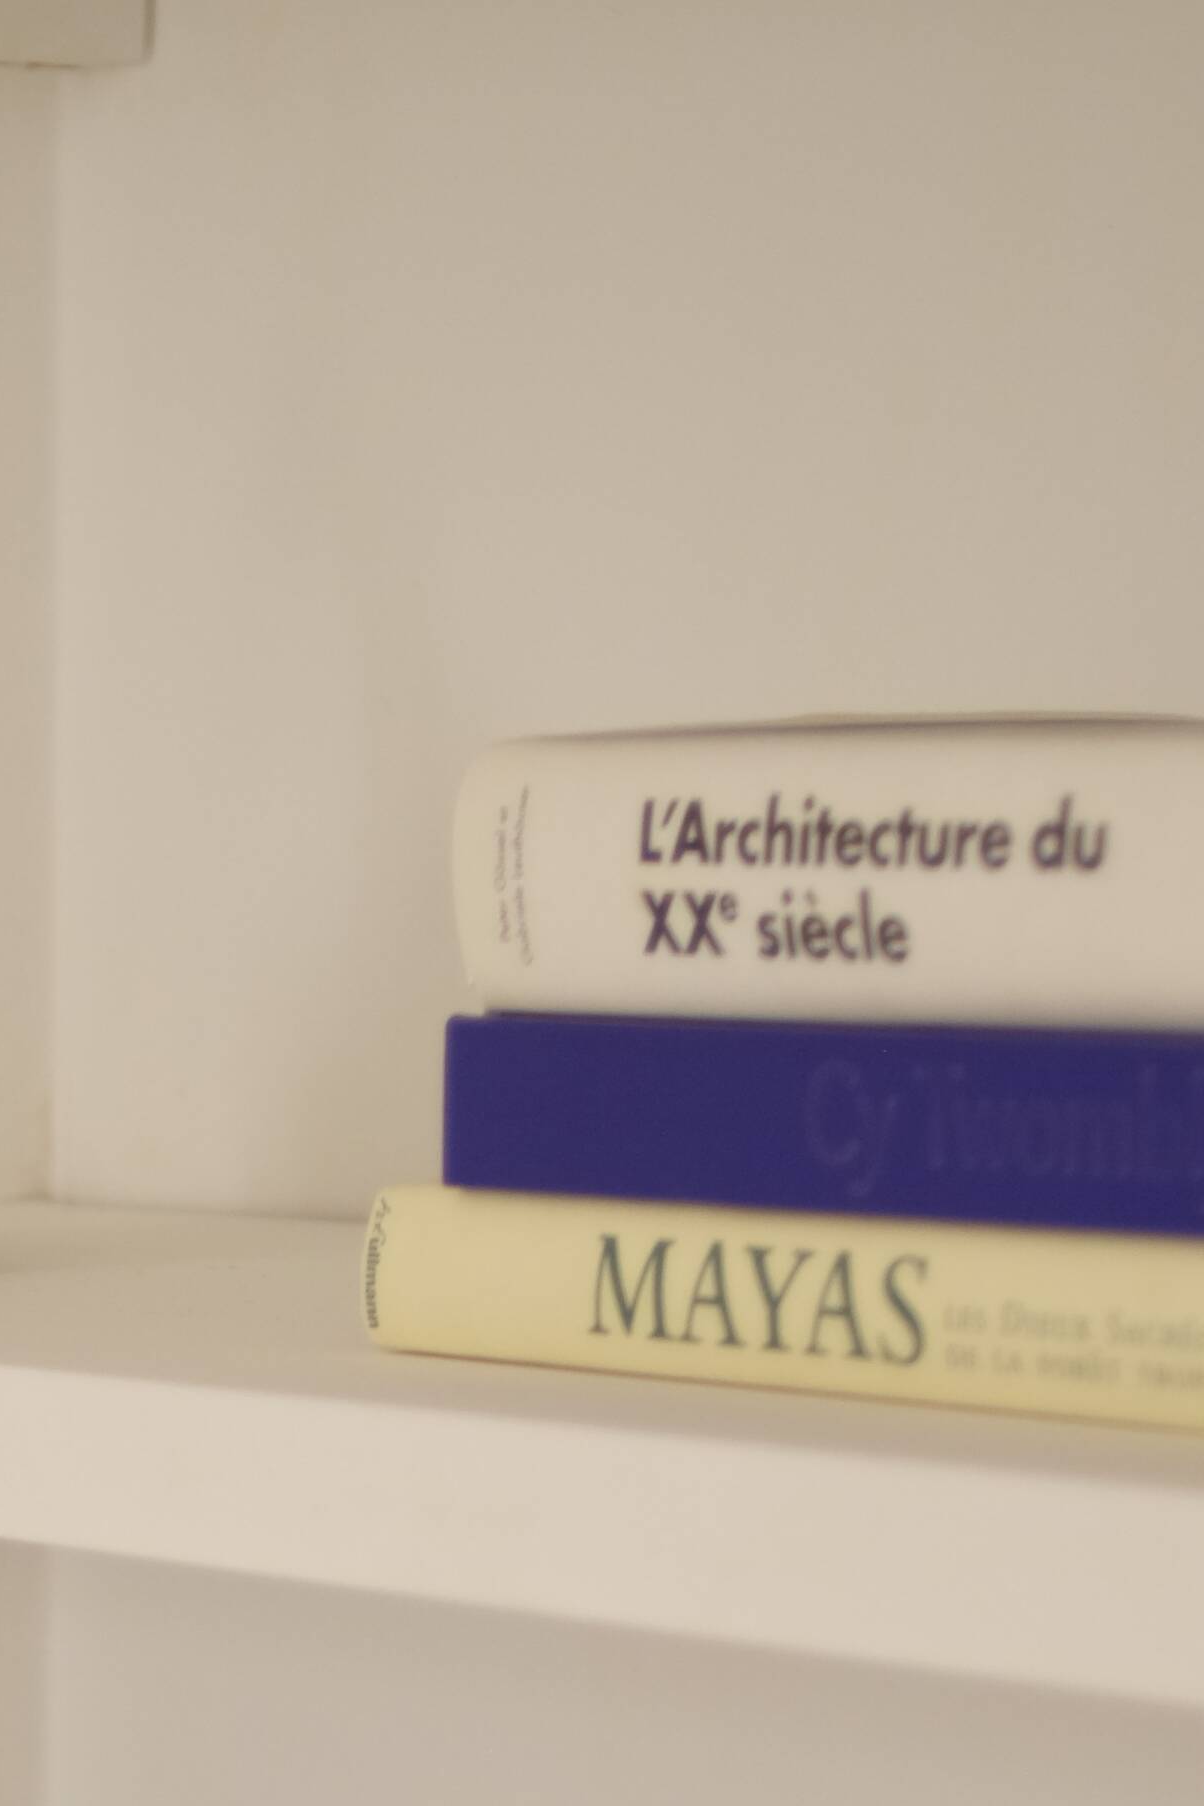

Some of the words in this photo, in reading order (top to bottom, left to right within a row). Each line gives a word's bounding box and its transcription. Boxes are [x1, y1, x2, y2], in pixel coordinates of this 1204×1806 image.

[638, 793, 1013, 869] L'Architecture
[1031, 794, 1109, 871] du
[756, 887, 909, 962] siècle
[588, 1233, 930, 1368] MAYAS
